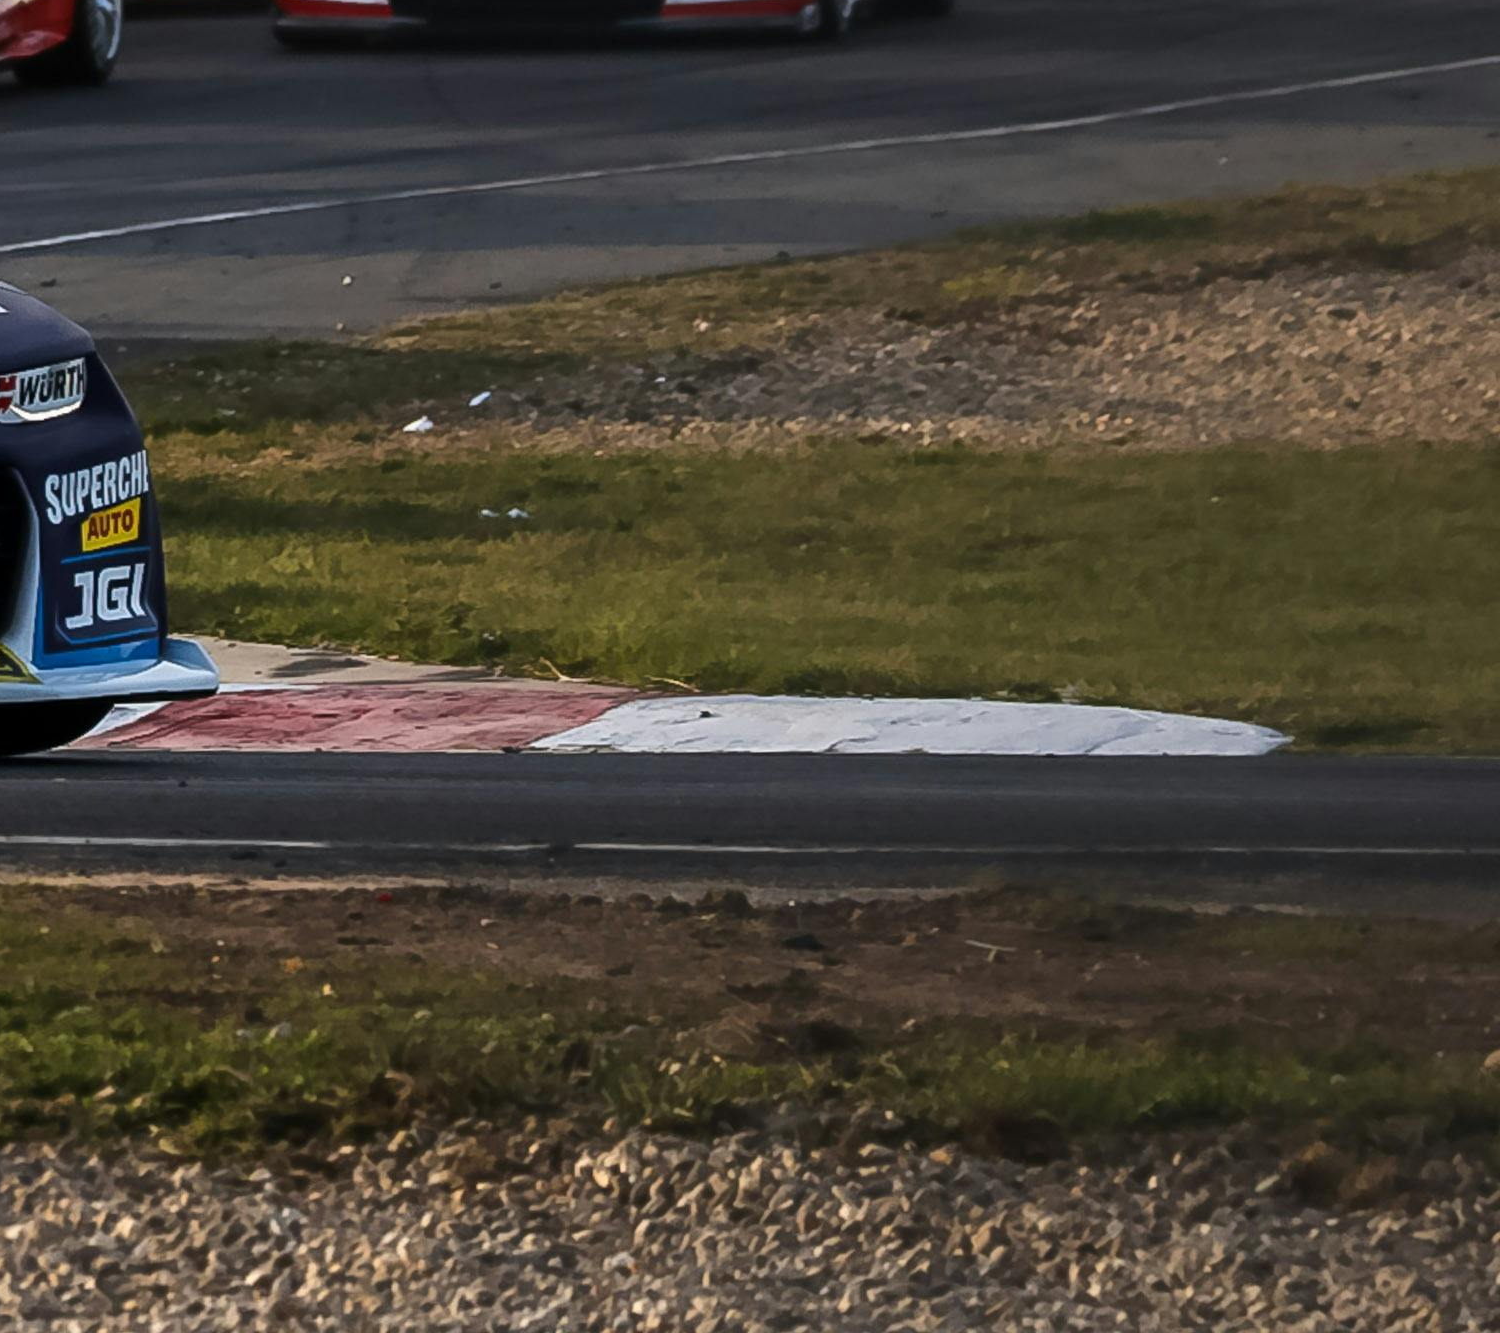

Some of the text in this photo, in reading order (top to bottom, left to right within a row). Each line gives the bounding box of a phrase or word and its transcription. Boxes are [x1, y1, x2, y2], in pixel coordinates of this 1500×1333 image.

[17, 363, 86, 407] WÜRTH
[86, 508, 134, 542] AUTO
[64, 563, 148, 631] JGI
